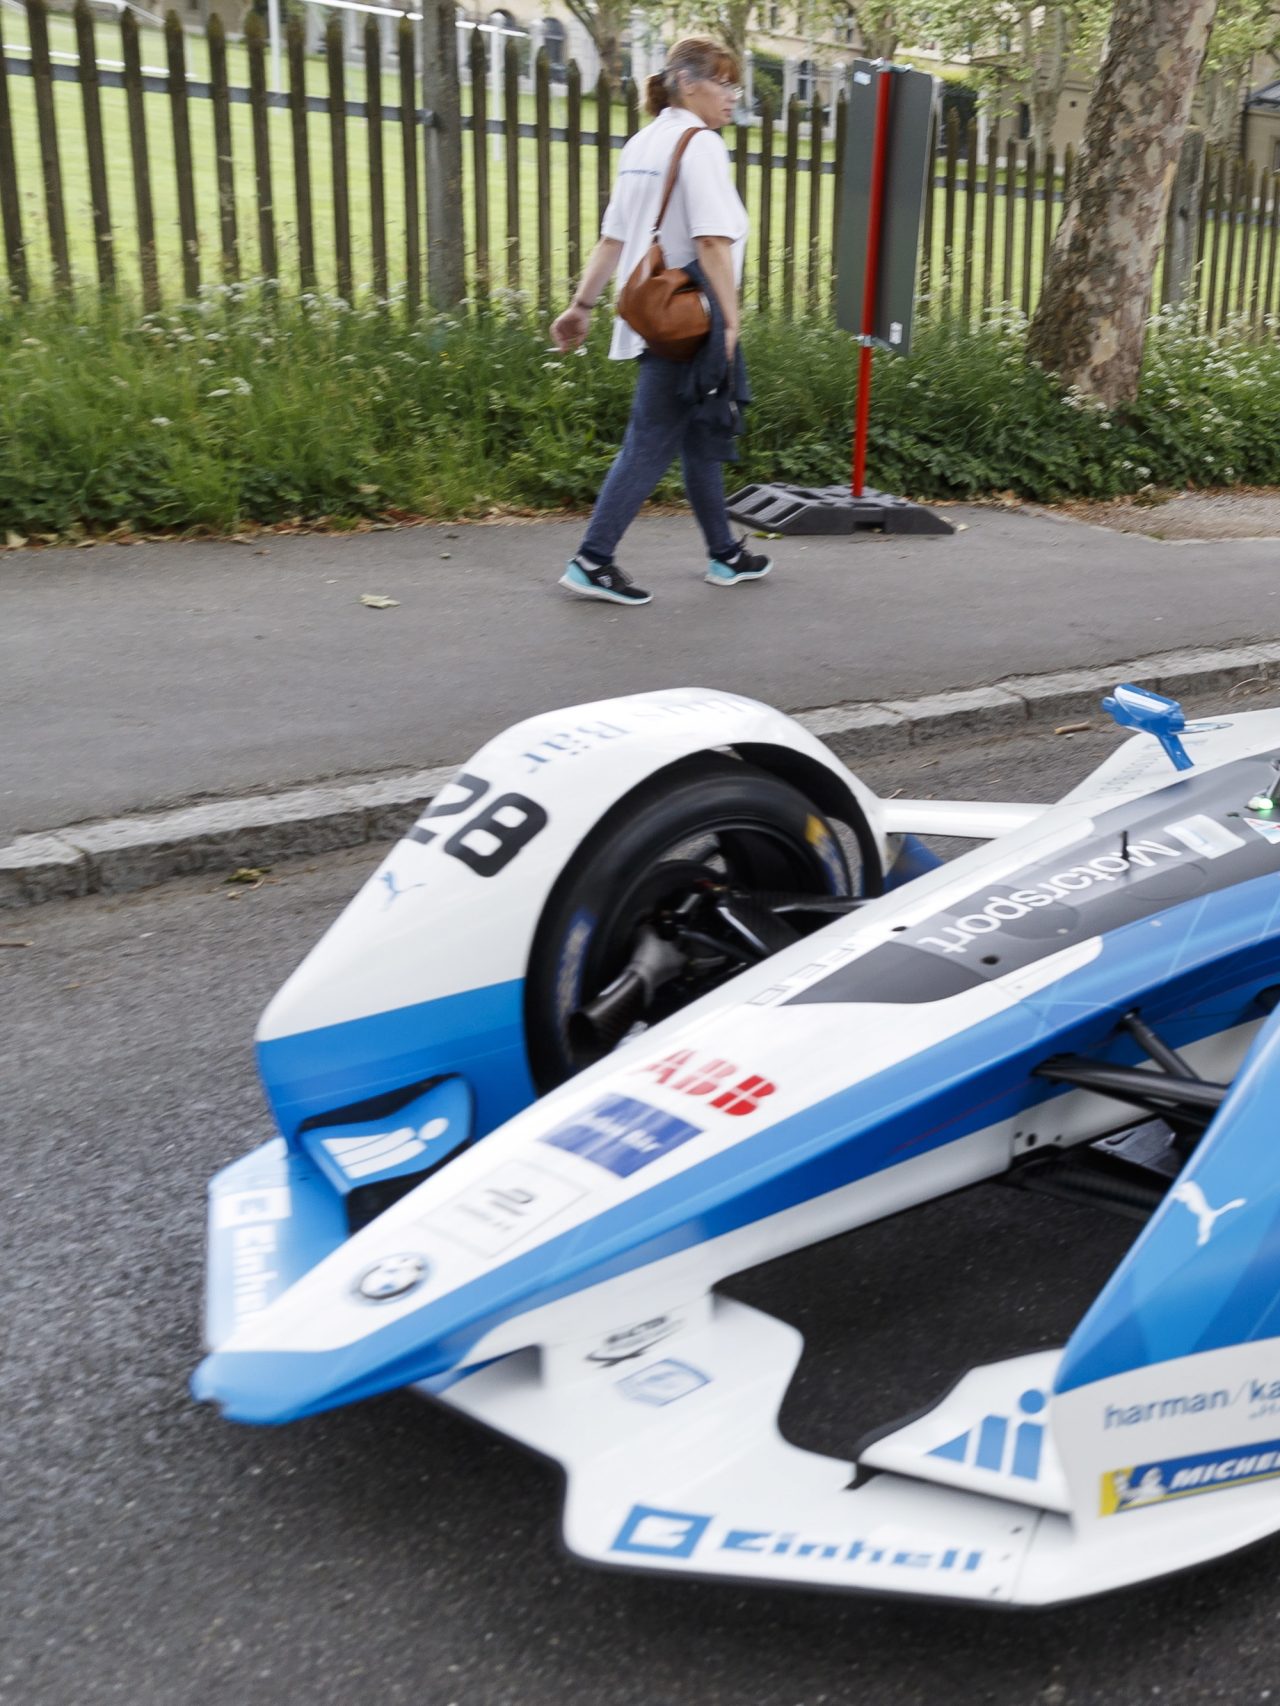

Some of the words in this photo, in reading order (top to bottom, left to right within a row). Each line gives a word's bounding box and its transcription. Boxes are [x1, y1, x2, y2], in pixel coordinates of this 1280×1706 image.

[403, 771, 549, 878] 28
[916, 838, 1182, 955] Motorsport
[634, 1049, 777, 1118] ABB
[718, 1529, 985, 1574] Einhell
